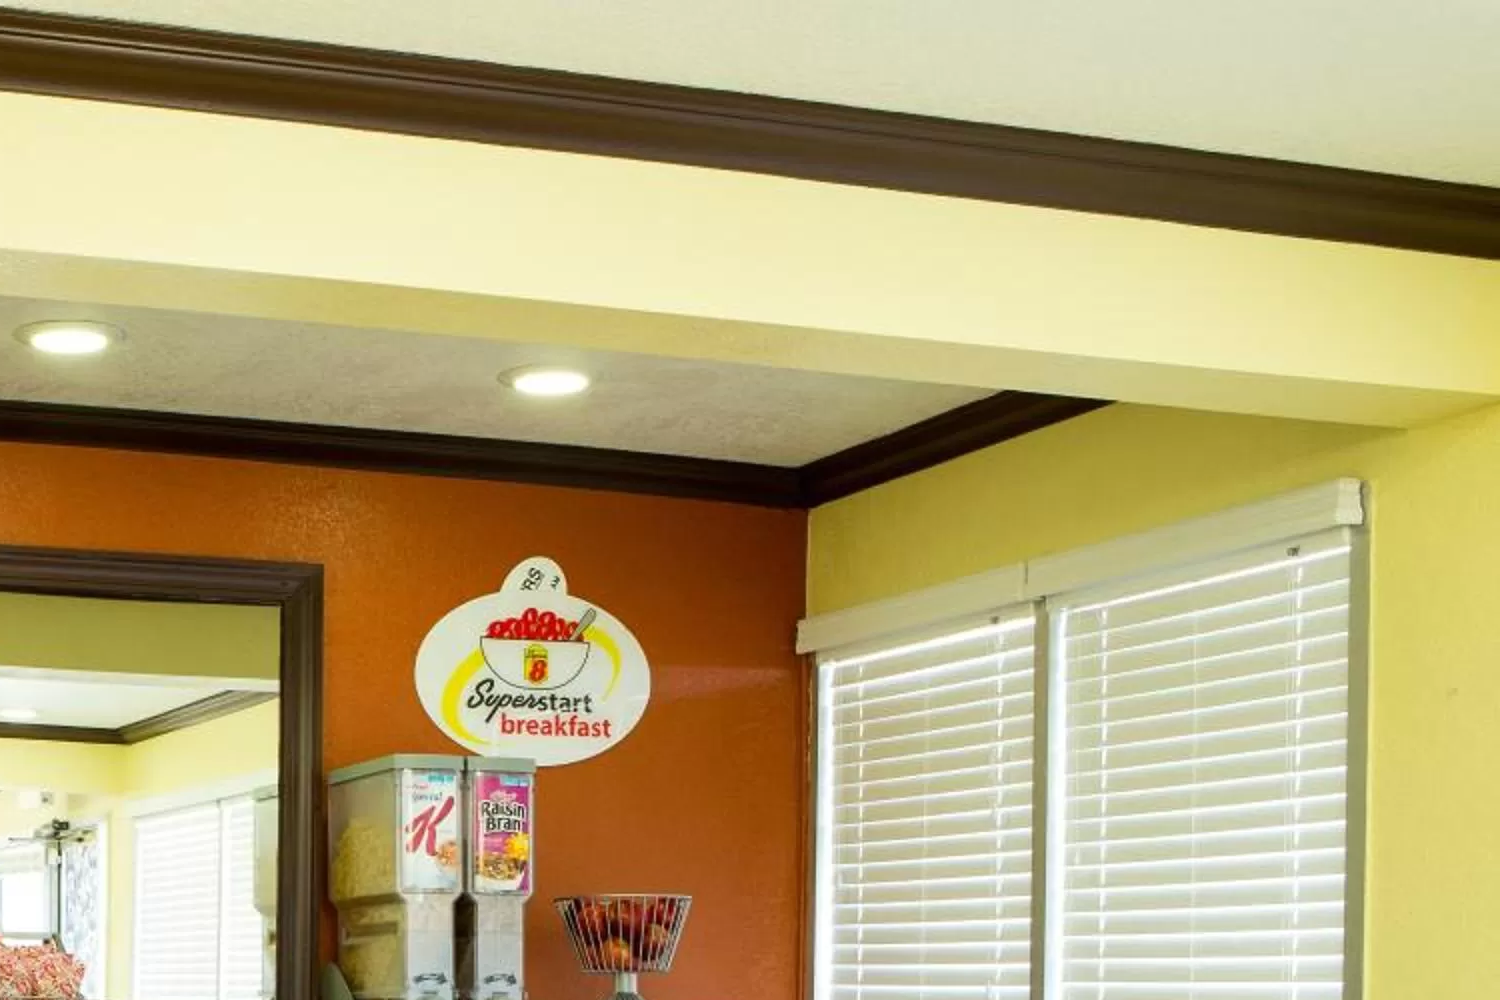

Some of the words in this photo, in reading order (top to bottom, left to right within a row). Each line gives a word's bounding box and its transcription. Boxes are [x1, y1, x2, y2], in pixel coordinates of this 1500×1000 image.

[519, 567, 542, 591] RS
[529, 659, 548, 683] 8
[467, 678, 593, 724] Superstart
[500, 712, 612, 738] breakfast
[481, 801, 525, 818] Raisin
[405, 796, 455, 857] K
[485, 817, 521, 832] Bran
